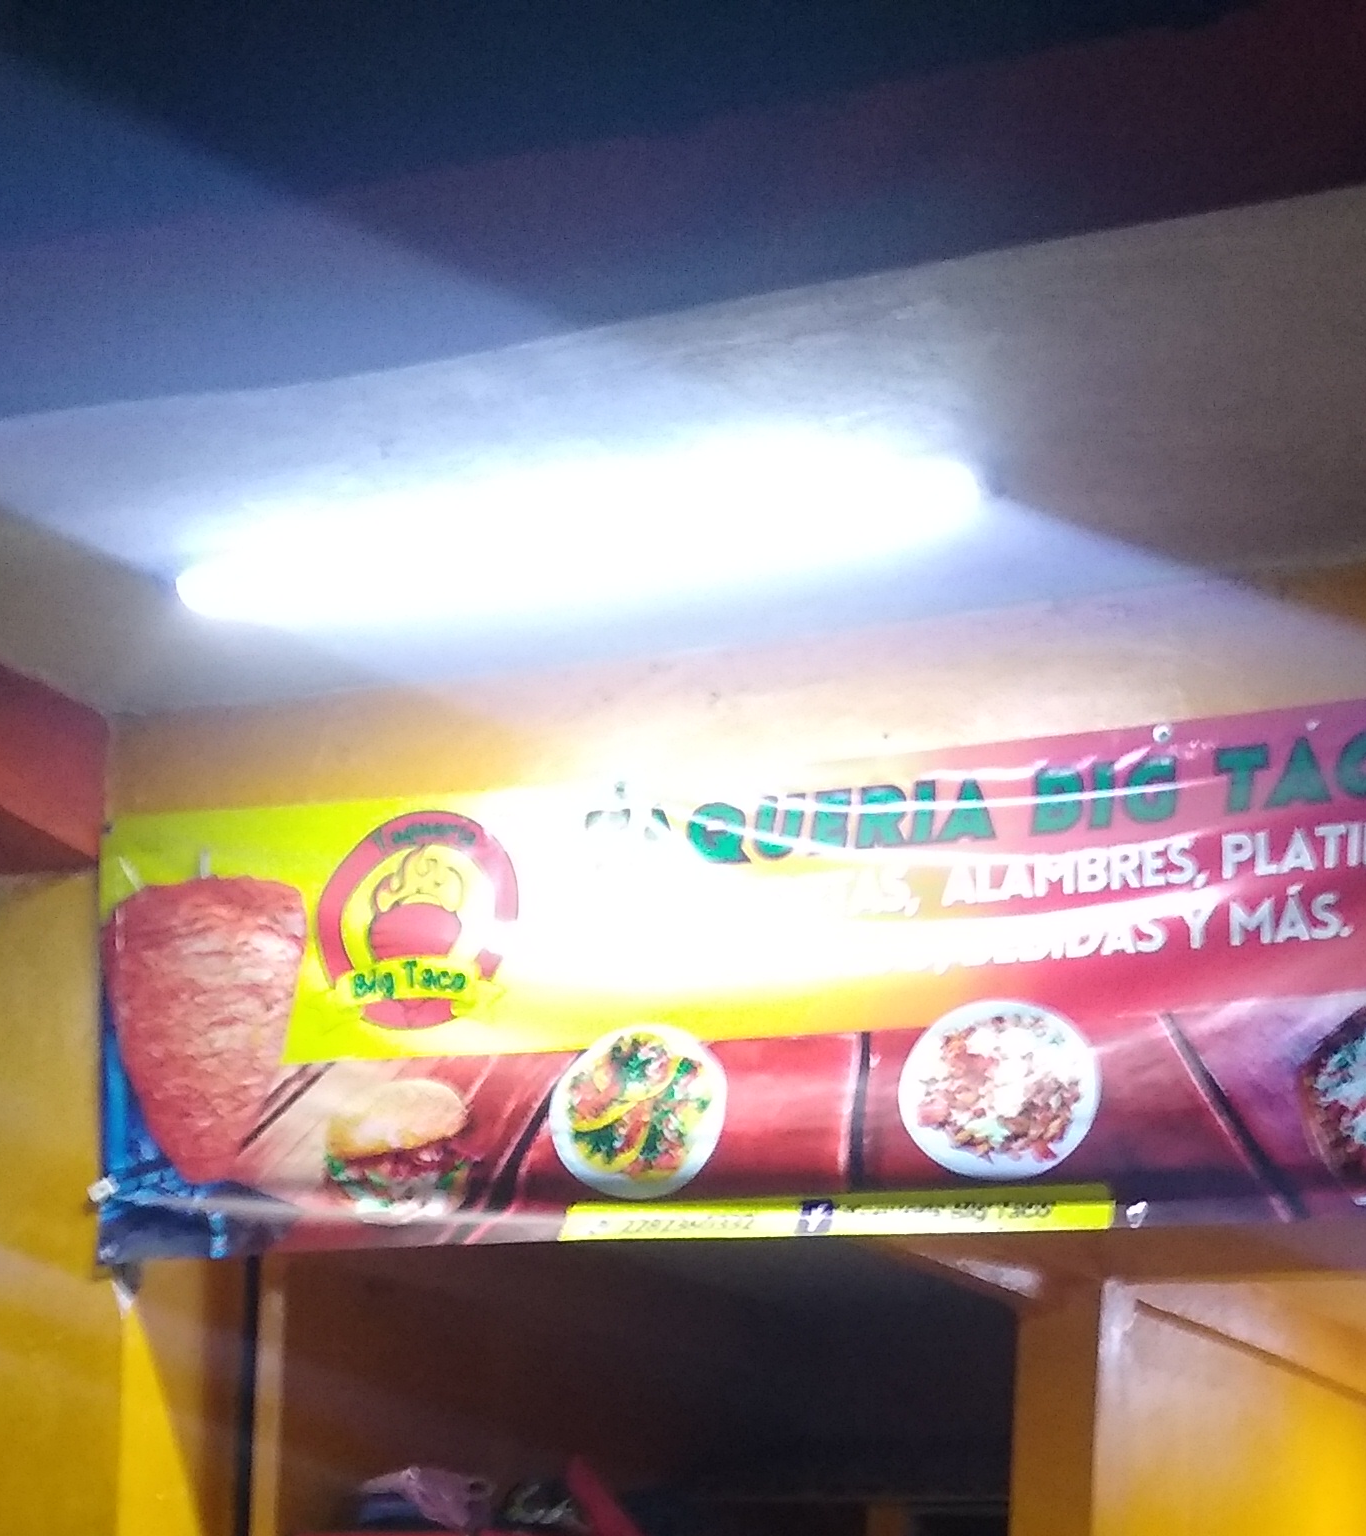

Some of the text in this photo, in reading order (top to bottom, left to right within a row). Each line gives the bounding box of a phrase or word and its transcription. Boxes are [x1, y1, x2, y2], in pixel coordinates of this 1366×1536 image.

[1030, 755, 1178, 836] BIG
[943, 833, 1211, 908] ALAMBRES,
[1229, 885, 1353, 948] MÁS.
[401, 959, 467, 993] Taco
